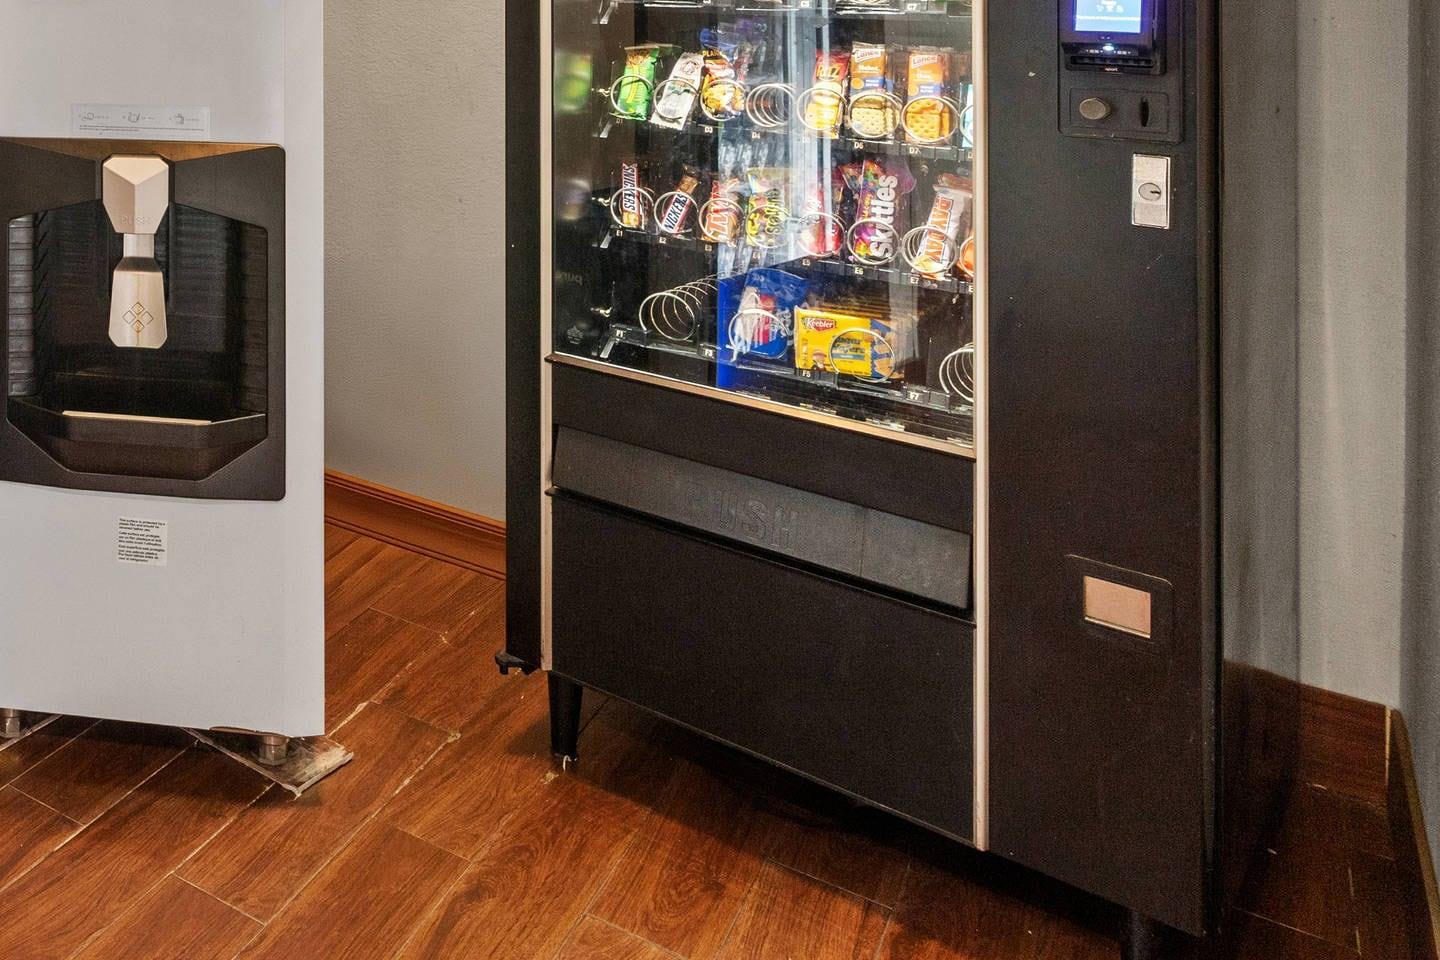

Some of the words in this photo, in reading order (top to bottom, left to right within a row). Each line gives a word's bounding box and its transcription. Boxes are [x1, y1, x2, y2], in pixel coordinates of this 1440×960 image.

[855, 49, 880, 59] Lance
[912, 56, 937, 65] Lance
[817, 64, 840, 78] RITZ
[624, 164, 636, 211] SNICKERS
[663, 193, 688, 231] NICKERS
[870, 176, 898, 258] Skittles
[924, 194, 954, 262] PAYDAY
[806, 318, 834, 329] Keebler
